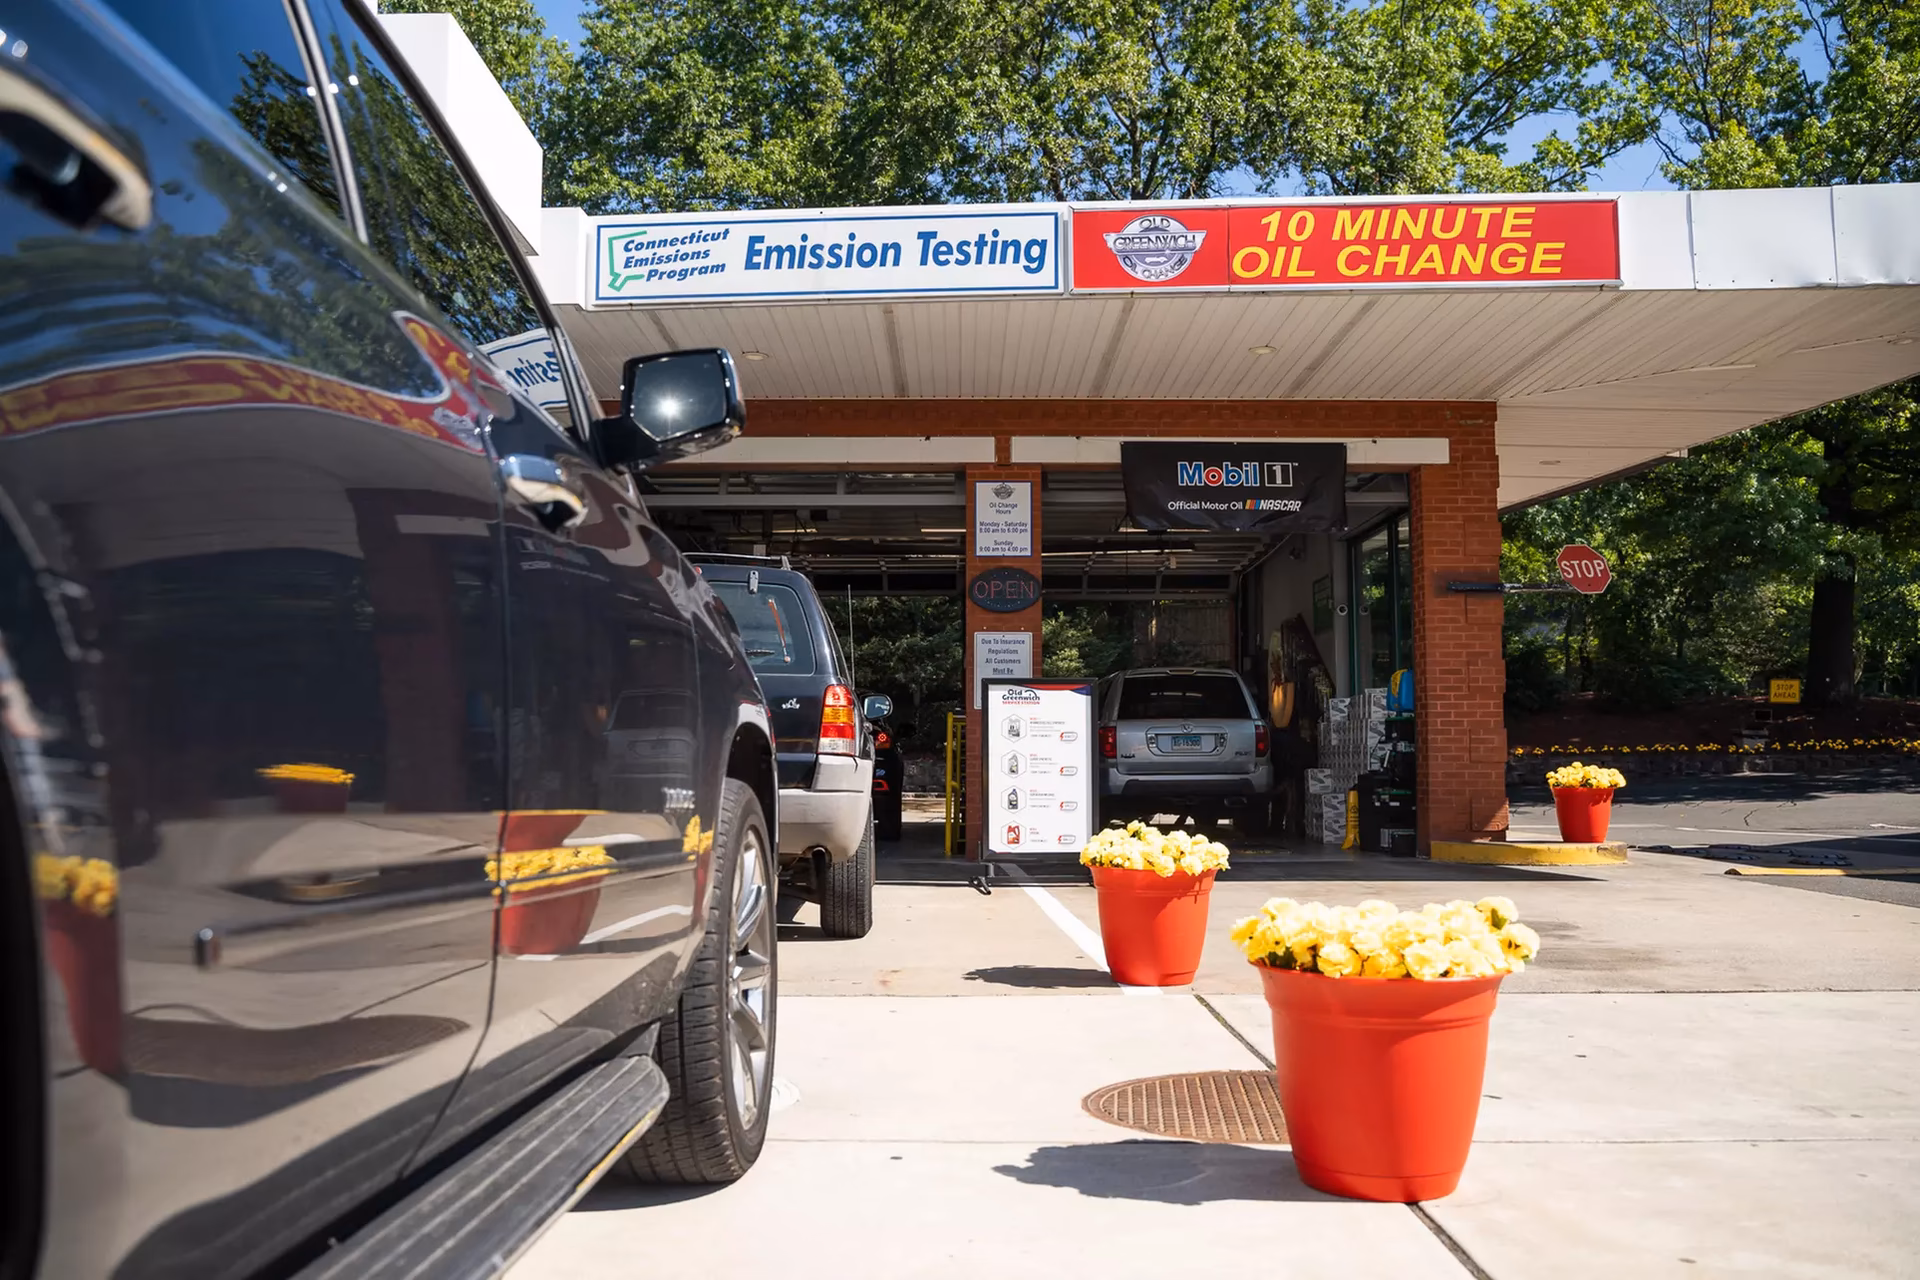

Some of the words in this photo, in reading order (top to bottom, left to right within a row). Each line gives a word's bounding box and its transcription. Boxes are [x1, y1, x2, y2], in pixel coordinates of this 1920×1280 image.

[1139, 218, 1171, 229] OLD
[1260, 210, 1315, 242] 10
[1332, 207, 1537, 241] MINUTE
[623, 228, 729, 252] Connecticut
[1113, 235, 1196, 251] GREENWICH
[623, 249, 711, 269] Emissions
[744, 232, 901, 271] Emission
[917, 228, 1048, 274] Testing
[1232, 245, 1316, 279] OIL
[1335, 242, 1566, 277] CHANGE
[646, 263, 726, 282] Program
[1123, 255, 1138, 275] OIL
[1142, 254, 1188, 280] CHANGE
[1178, 461, 1260, 487] Mobil
[1168, 501, 1200, 510] Official
[1201, 501, 1229, 510] Motor
[1230, 501, 1243, 510] Oil
[1259, 499, 1302, 511] NASCAR
[1561, 560, 1604, 578] STOP
[974, 581, 1034, 599] OPEN
[1002, 693, 1040, 701] Greenwich
